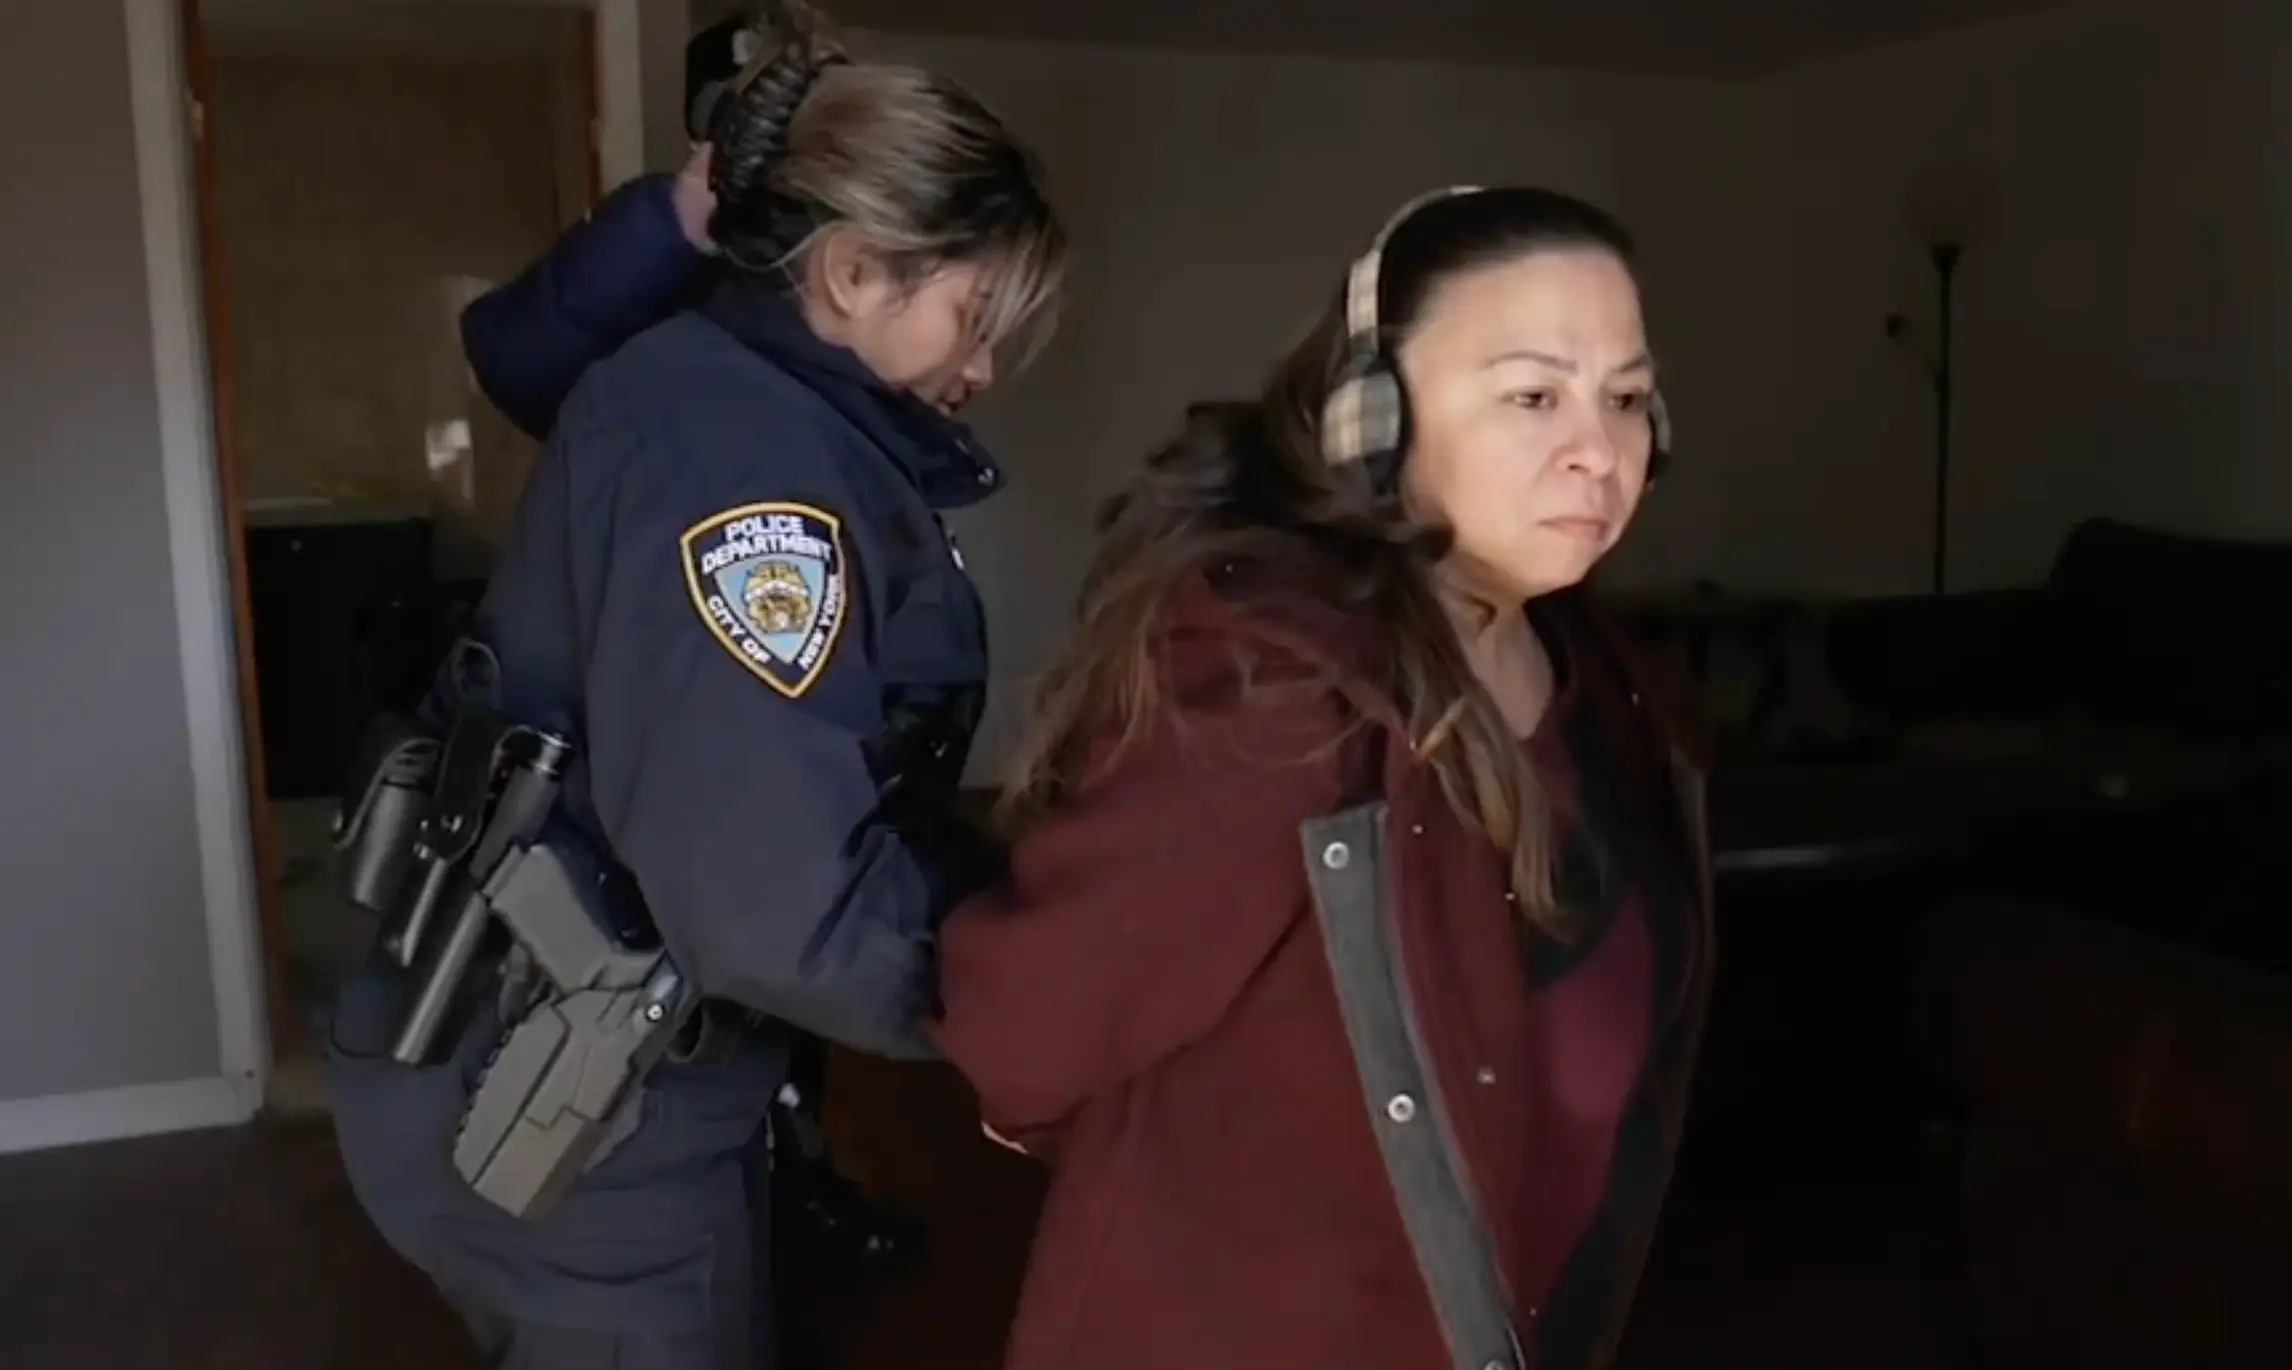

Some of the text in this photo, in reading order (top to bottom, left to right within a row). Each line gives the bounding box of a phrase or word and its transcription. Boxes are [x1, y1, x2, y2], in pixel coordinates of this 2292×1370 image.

[724, 515, 804, 542] POLICE
[701, 534, 832, 575] DEPARTMENT
[707, 595, 772, 664] CITY OF
